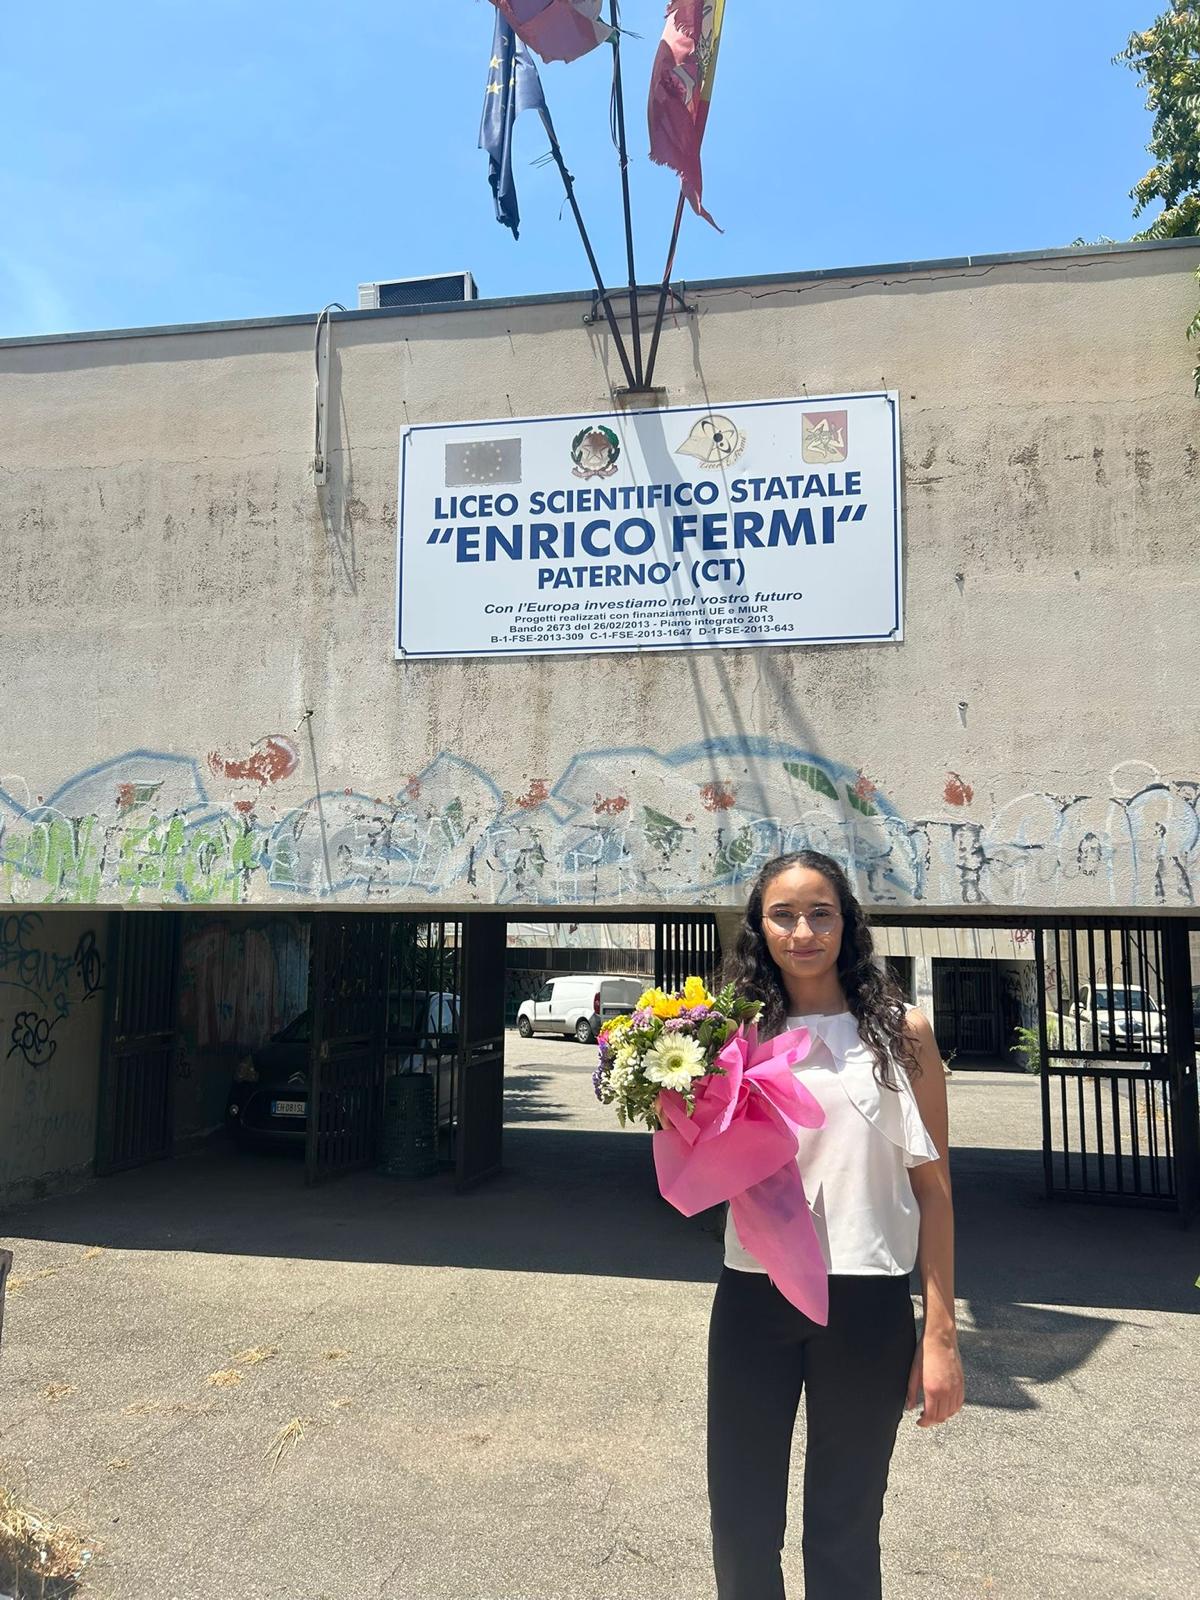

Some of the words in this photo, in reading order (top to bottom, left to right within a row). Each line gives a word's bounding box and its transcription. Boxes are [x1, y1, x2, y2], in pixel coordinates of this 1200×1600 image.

[434, 493, 519, 520] LICEO
[529, 481, 719, 515] SCIENTIFICO
[730, 471, 862, 503] STATALE
[426, 517, 656, 563] "ENRICO
[672, 504, 868, 553] FERMI"
[538, 561, 681, 590] PATERNO'
[691, 558, 746, 589] (CT)
[484, 603, 514, 614] Con
[518, 602, 580, 614] l'Europa
[584, 598, 667, 611] investiamo
[672, 595, 696, 606] nel
[700, 594, 750, 605] vostro
[754, 591, 803, 602] futuro
[509, 624, 544, 633] Bando
[546, 624, 571, 632] 2673
[574, 622, 591, 631] del
[593, 620, 650, 630] 26/02/2013
[660, 619, 691, 628] Piano
[694, 617, 745, 627] integrato
[747, 615, 774, 623] 2013
[514, 615, 556, 624] Progetti
[559, 613, 606, 622] realizzati
[609, 612, 630, 620] con
[632, 608, 706, 619] finanziamenti
[709, 607, 725, 616] UE
[738, 605, 768, 614] MIUR
[490, 632, 584, 643] B-1-FSE-2013-309
[590, 628, 692, 640] C-1-FSE-2013-1647
[698, 623, 795, 636] D-1FSE-2013-643
